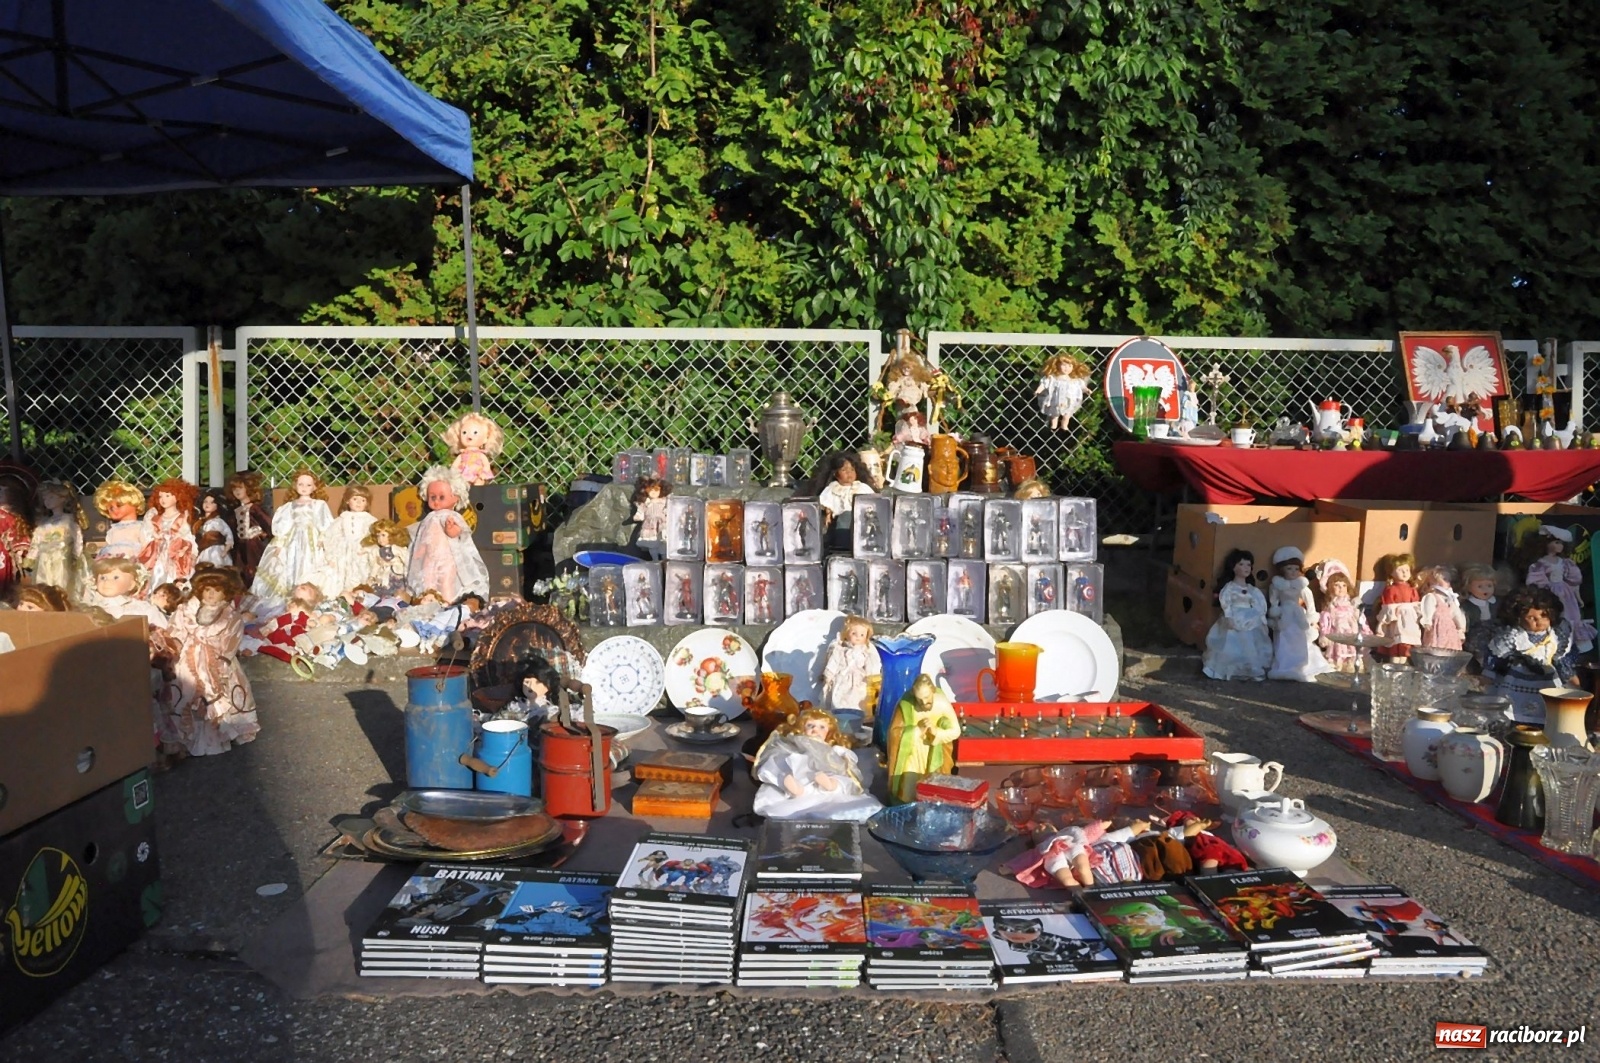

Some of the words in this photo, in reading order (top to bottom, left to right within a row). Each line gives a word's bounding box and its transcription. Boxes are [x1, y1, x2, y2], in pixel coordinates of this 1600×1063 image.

[434, 868, 505, 882] BATMAN
[558, 876, 599, 885] BATMAN
[1230, 876, 1262, 884] FLASH
[1100, 891, 1132, 899] GREEN
[1133, 889, 1168, 897] ARROW
[1000, 907, 1054, 915] CATWOMAN
[410, 924, 450, 935] HUSH
